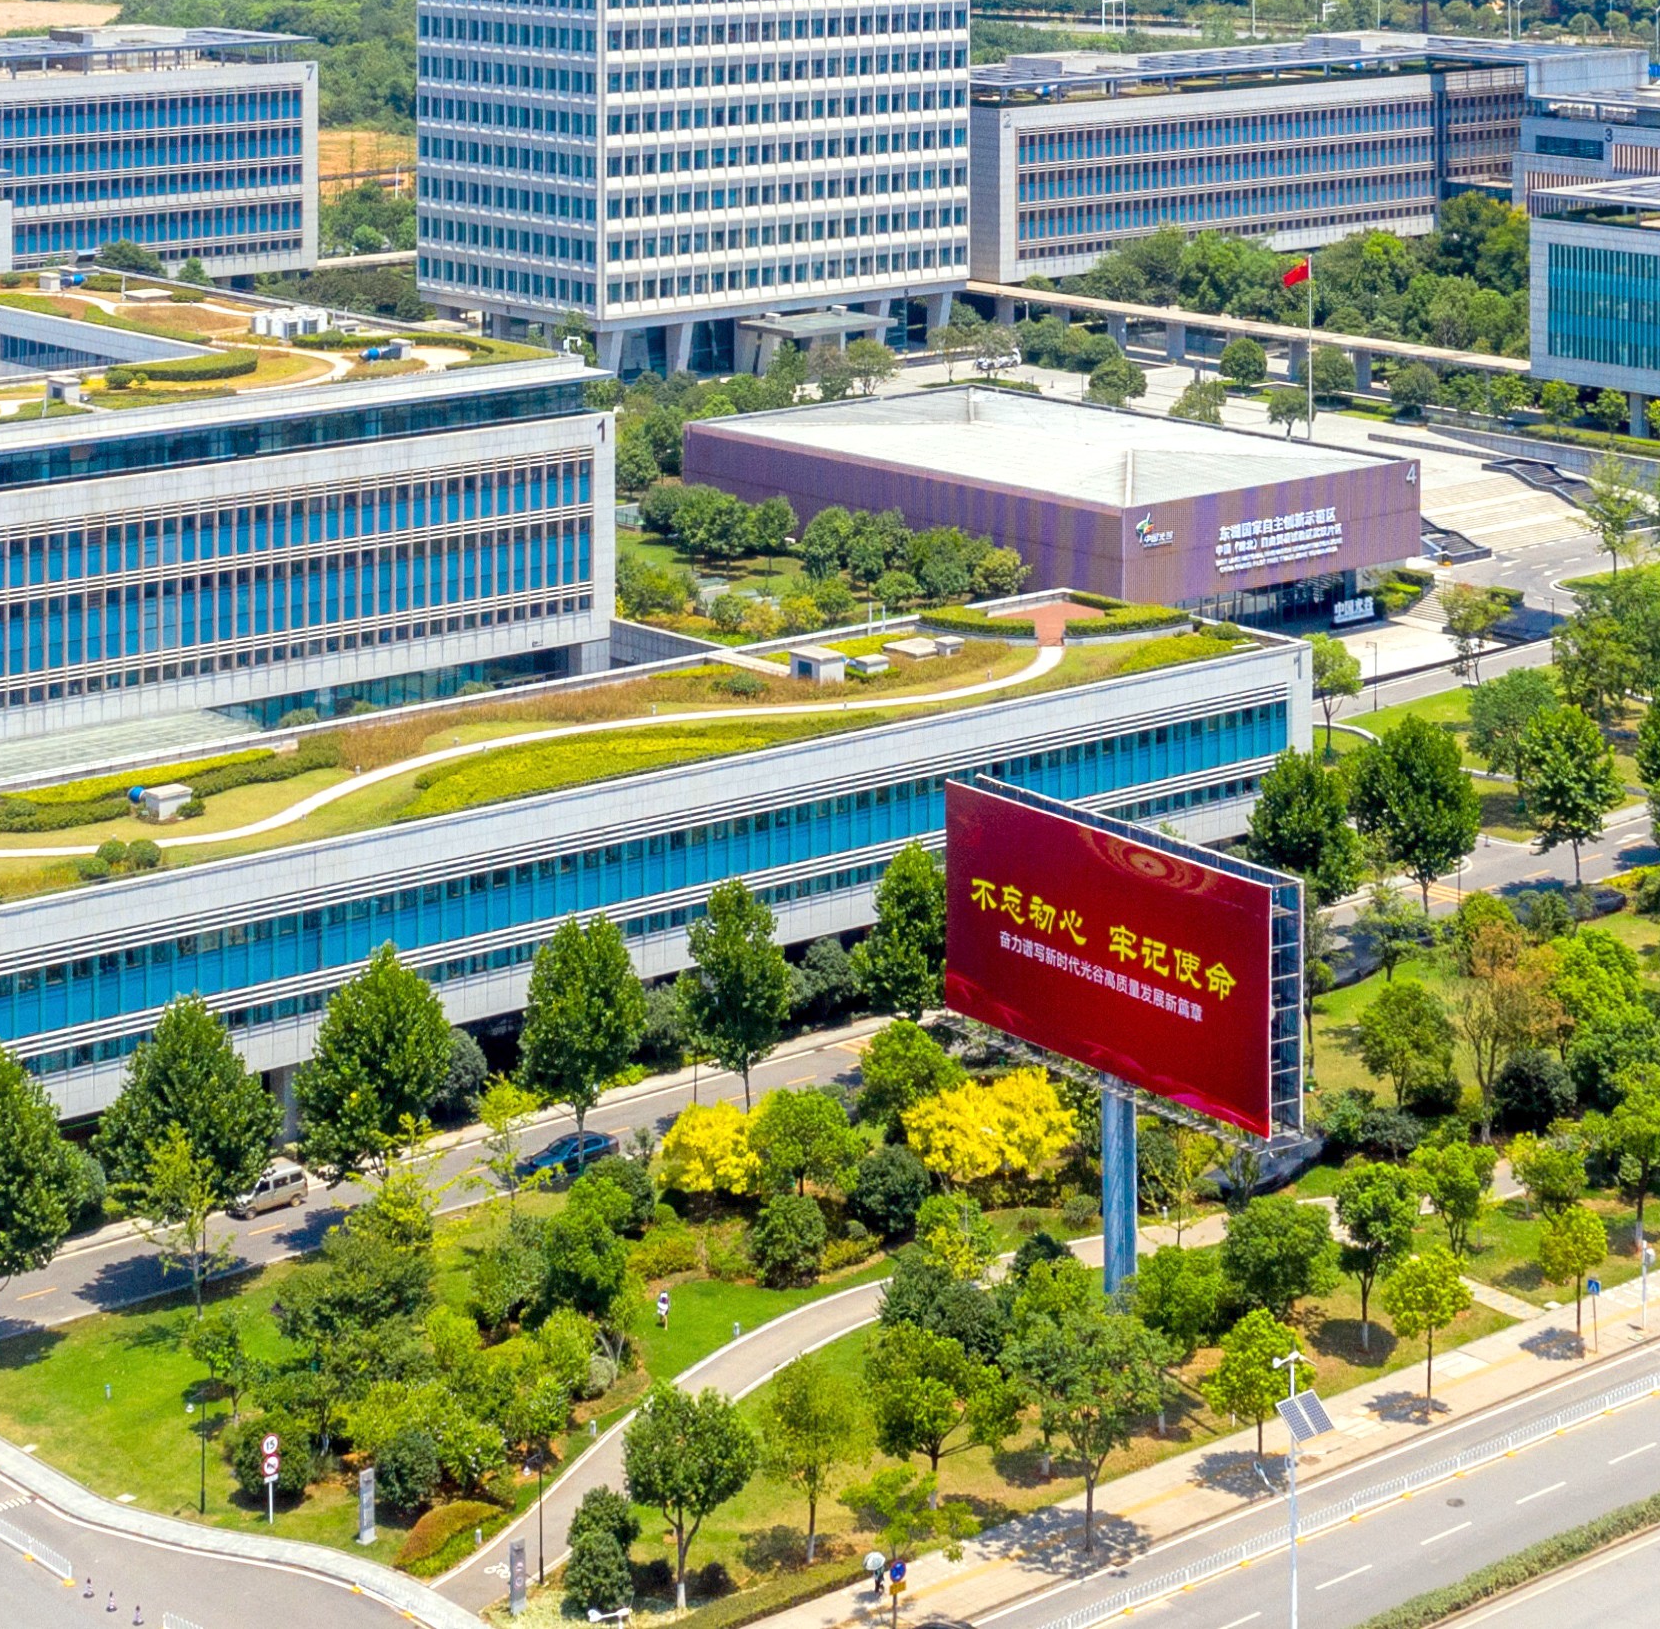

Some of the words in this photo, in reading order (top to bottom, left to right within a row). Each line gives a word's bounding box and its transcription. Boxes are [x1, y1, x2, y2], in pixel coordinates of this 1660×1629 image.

[306, 63, 316, 81] 7
[1003, 113, 1011, 128] 2
[1605, 127, 1613, 142] 3
[597, 418, 606, 443] 1
[1406, 463, 1417, 485] 4
[971, 878, 1087, 946] 不忘初心
[1109, 925, 1237, 1001] 牢记使命
[999, 930, 1203, 1022] 奋力谱写新时代光谷高质量发展新篇章
[266, 1439, 276, 1451] 15
